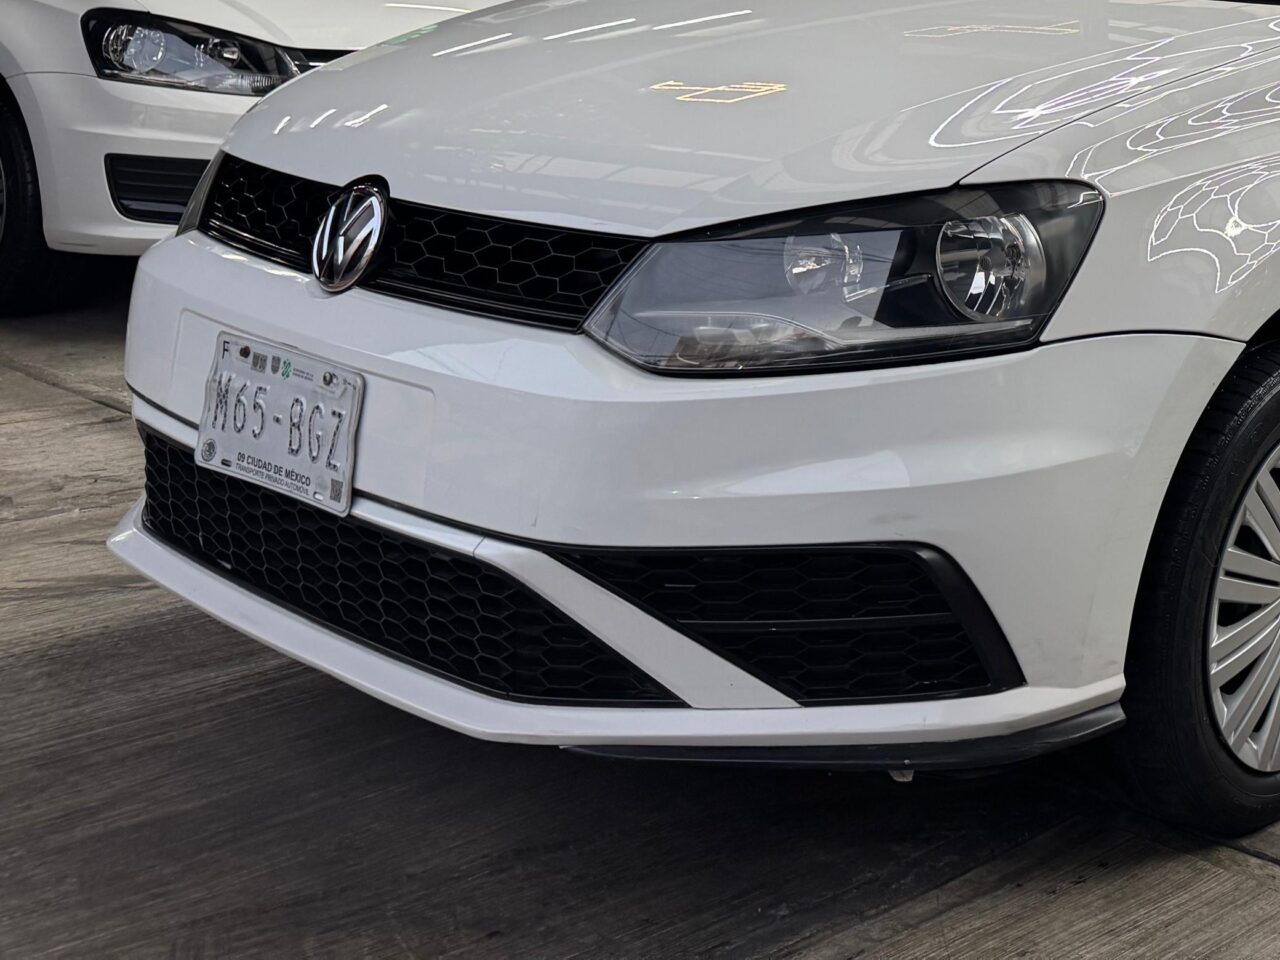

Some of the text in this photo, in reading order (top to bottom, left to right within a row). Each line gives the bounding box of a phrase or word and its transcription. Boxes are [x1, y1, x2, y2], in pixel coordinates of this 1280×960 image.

[221, 340, 230, 359] F
[211, 373, 344, 472] M65-BGZ
[236, 463, 265, 480] TRANSPORTE
[265, 473, 284, 486] PRIVADO
[237, 452, 311, 487] 09 CIUDAD DE MÉXICO
